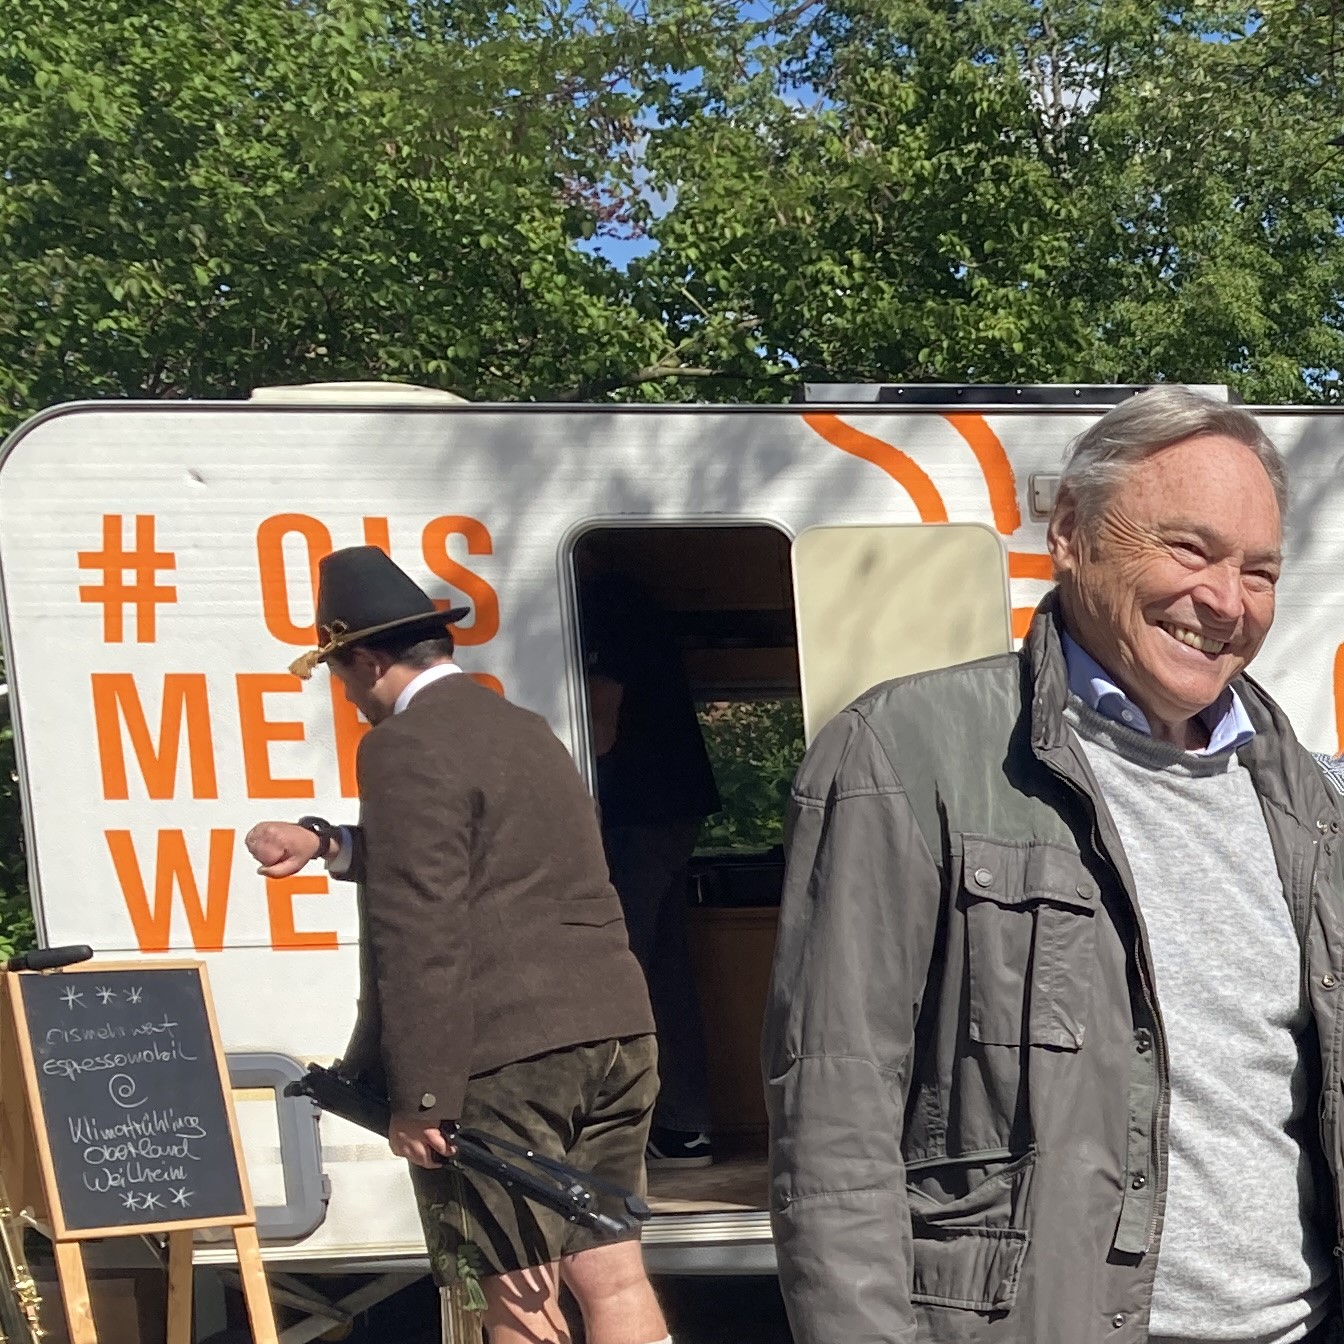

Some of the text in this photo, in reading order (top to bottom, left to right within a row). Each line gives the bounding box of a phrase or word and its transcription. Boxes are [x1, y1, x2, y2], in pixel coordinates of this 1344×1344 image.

[77, 513, 501, 646] # OS
[83, 1160, 188, 1193] Weilheim
